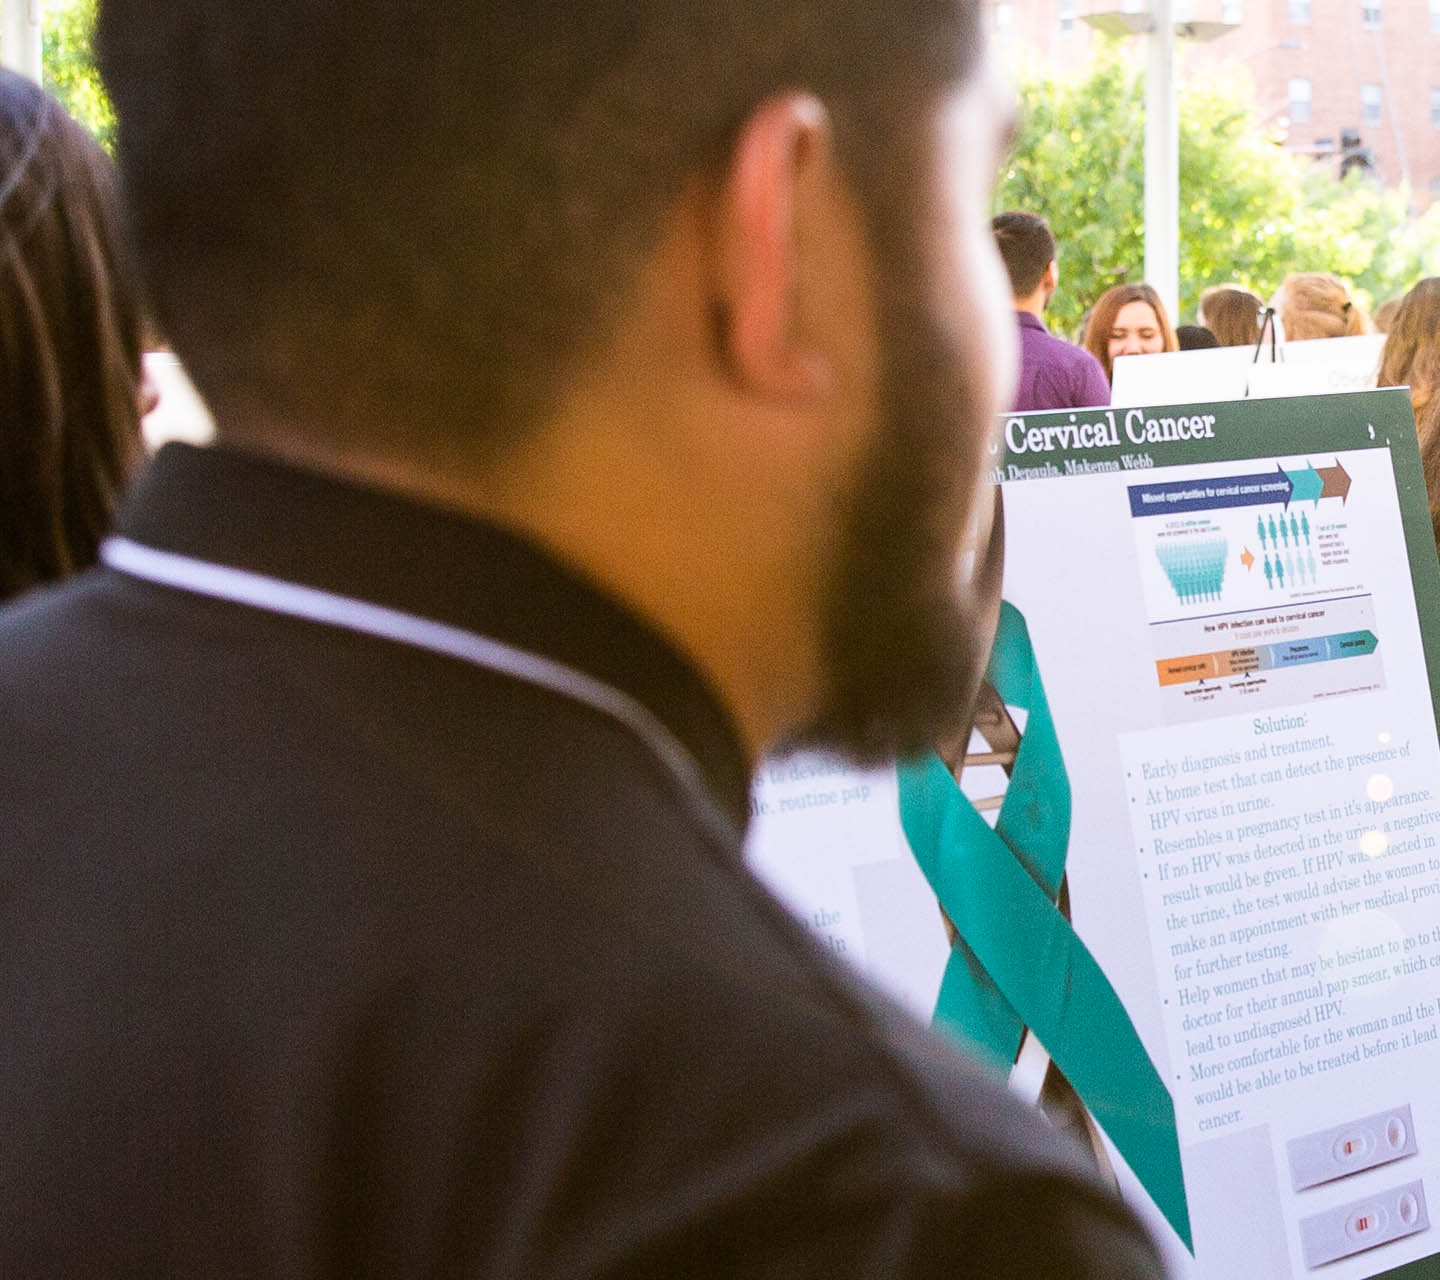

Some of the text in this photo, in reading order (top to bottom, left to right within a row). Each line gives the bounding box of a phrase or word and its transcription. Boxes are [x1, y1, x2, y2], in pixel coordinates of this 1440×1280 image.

[1005, 411, 1120, 454] Cervical
[1125, 410, 1216, 445] Cancer
[1121, 453, 1154, 471] Webb
[1141, 759, 1178, 780] Early
[1181, 749, 1242, 774] diagnosis
[1244, 741, 1268, 762] and
[1145, 739, 1411, 806] At home test that can detect the presence of
[1149, 808, 1180, 831] HPV
[1184, 806, 1219, 823] virus
[1220, 800, 1236, 817] in
[1153, 790, 1433, 856] Resembles a pregnancy test in it's appearance.
[1158, 862, 1169, 881] If
[1172, 864, 1189, 879] no
[1191, 851, 1222, 874] HPV
[1225, 851, 1251, 865] was
[1253, 834, 1305, 861] detected
[1306, 833, 1321, 849] in
[1322, 828, 1343, 846] the
[1383, 821, 1392, 833] a
[1393, 809, 1440, 832] negative
[1162, 883, 1201, 907] result
[1203, 873, 1243, 896] would
[1244, 871, 1261, 888] be
[1302, 857, 1313, 875] If
[1315, 850, 1344, 872] HPV
[1374, 834, 1421, 861] tected
[1423, 832, 1436, 849] in
[1165, 912, 1188, 931] the
[1232, 897, 1254, 916] the
[1255, 893, 1281, 911] test
[1282, 881, 1320, 904] would
[1322, 875, 1361, 895] advise
[1362, 869, 1382, 887] the
[1384, 863, 1421, 880] woman
[1421, 857, 1440, 873] to
[1170, 935, 1207, 957] make
[1209, 933, 1227, 948] an
[1229, 913, 1308, 944] appointment
[1310, 903, 1339, 923] with
[1340, 900, 1361, 917] her
[1364, 885, 1409, 910] medical
[1173, 963, 1193, 982] for
[1195, 953, 1242, 976] further
[1178, 985, 1210, 1007] Help
[1212, 977, 1259, 997] women
[1260, 967, 1288, 985] that
[1290, 961, 1317, 979] may
[1317, 954, 1334, 971] be
[1336, 944, 1386, 967] hesitant
[1387, 941, 1400, 954] to
[1402, 937, 1416, 954] go
[1417, 933, 1430, 946] to
[1182, 1010, 1223, 1031] doctor
[1225, 1002, 1244, 1021] for
[1246, 993, 1278, 1015] their
[1280, 980, 1324, 1006] annual
[1326, 979, 1349, 999] pap
[1392, 954, 1428, 976] which
[1185, 1034, 1215, 1057] lead
[1216, 1035, 1231, 1049] to
[1233, 1008, 1312, 1044] undiagnosed
[1189, 1062, 1225, 1082] More
[1227, 1038, 1301, 1072] comfortable
[1303, 1033, 1321, 1052] for
[1323, 1027, 1344, 1045] the
[1346, 1018, 1389, 1038] woman
[1391, 1005, 1414, 1027] and
[1415, 1002, 1435, 1020] the
[1194, 1080, 1234, 1106] would
[1235, 1077, 1252, 1095] be
[1254, 1069, 1281, 1090] able
[1284, 1068, 1298, 1081] to
[1298, 1060, 1314, 1077] be
[1316, 1045, 1361, 1072] treated
[1361, 1038, 1399, 1059] before
[1400, 1032, 1411, 1049] it
[1412, 1023, 1438, 1046] lead
